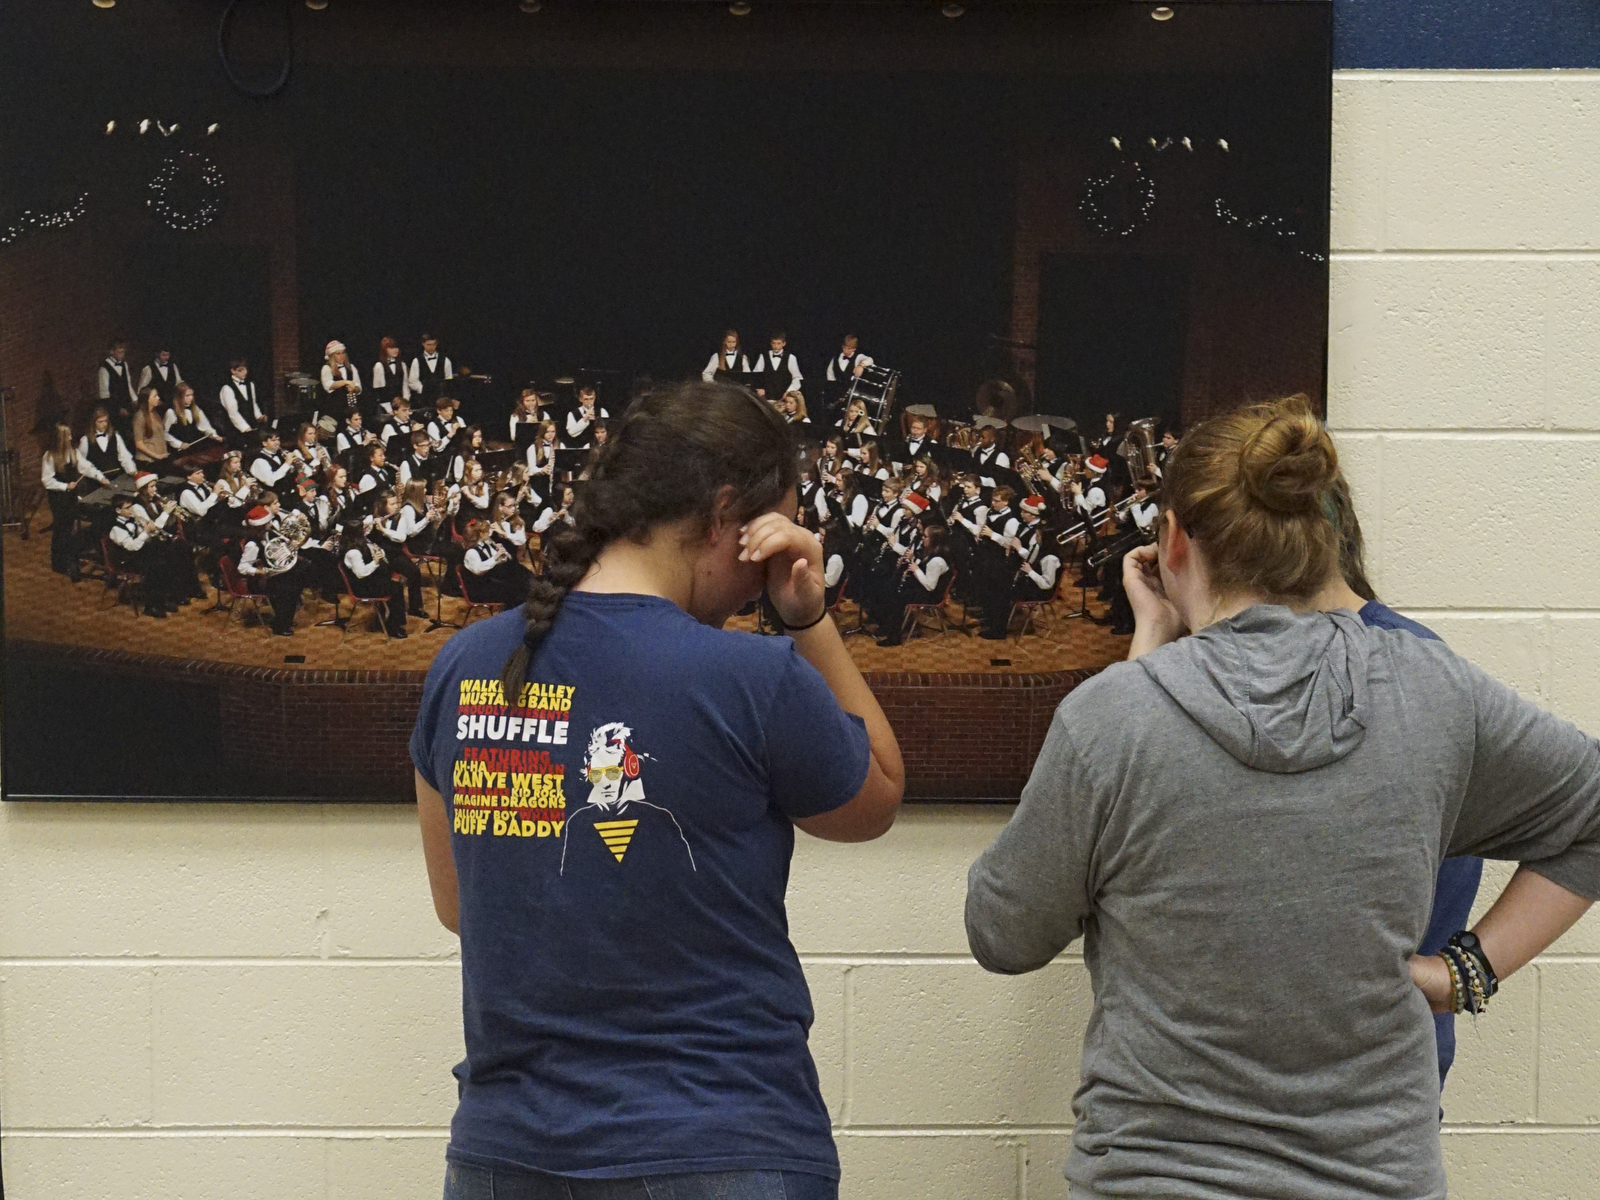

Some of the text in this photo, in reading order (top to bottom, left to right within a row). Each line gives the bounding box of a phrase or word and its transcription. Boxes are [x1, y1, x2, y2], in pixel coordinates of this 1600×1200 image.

[460, 679, 576, 699] WALKE VALLEY
[458, 705, 509, 716] PROUDLY
[459, 692, 572, 712] MUSTAG BAND
[456, 715, 569, 745] SHUFFLE
[464, 747, 550, 764] FEATURING
[455, 760, 488, 773] AH-HA
[453, 770, 565, 791] KANYE WEST
[453, 794, 499, 807] IMAGINE
[501, 796, 567, 810] DRAGONS
[511, 788, 531, 798] KID
[533, 787, 564, 800] ROCK
[493, 810, 518, 822] BOY
[454, 818, 566, 838] PUFF DADDY
